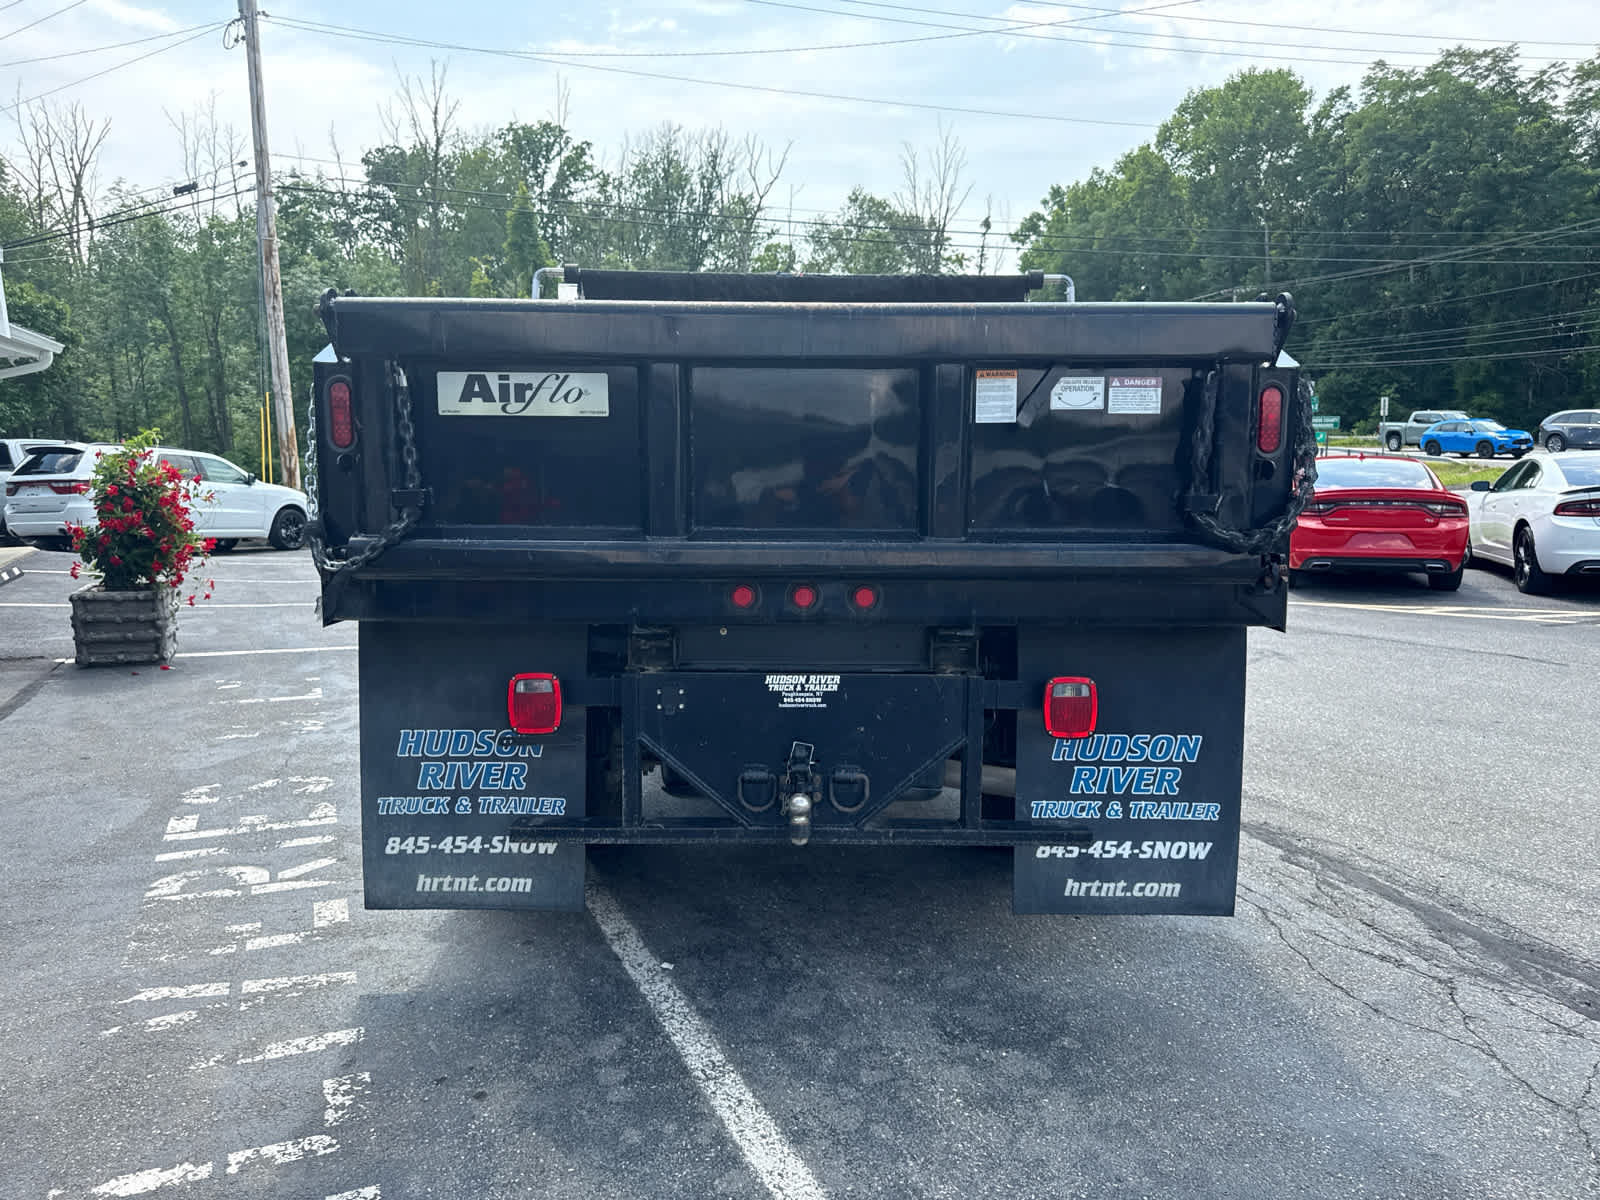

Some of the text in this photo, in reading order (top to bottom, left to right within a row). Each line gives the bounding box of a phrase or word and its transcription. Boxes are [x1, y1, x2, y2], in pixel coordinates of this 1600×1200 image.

[1060, 384, 1095, 392] OPERATION
[1124, 378, 1157, 386] DANGER
[458, 373, 584, 415] Airflo
[765, 675, 840, 684] HUDSON RIVER
[768, 684, 838, 692] TRUCK & TRAILER
[1051, 733, 1203, 763] HUDSON
[417, 761, 529, 791] RIVER
[1069, 766, 1182, 796] RIVER
[377, 796, 567, 816] TRUCK & TRAILER
[1031, 800, 1221, 821] TRUCK & TRAILER
[385, 836, 558, 855] 845-454-SNOW
[1035, 839, 1213, 860] 845-454-SNOW
[415, 873, 533, 893] hrtnt.com
[1063, 877, 1182, 898] hrtnt.com
